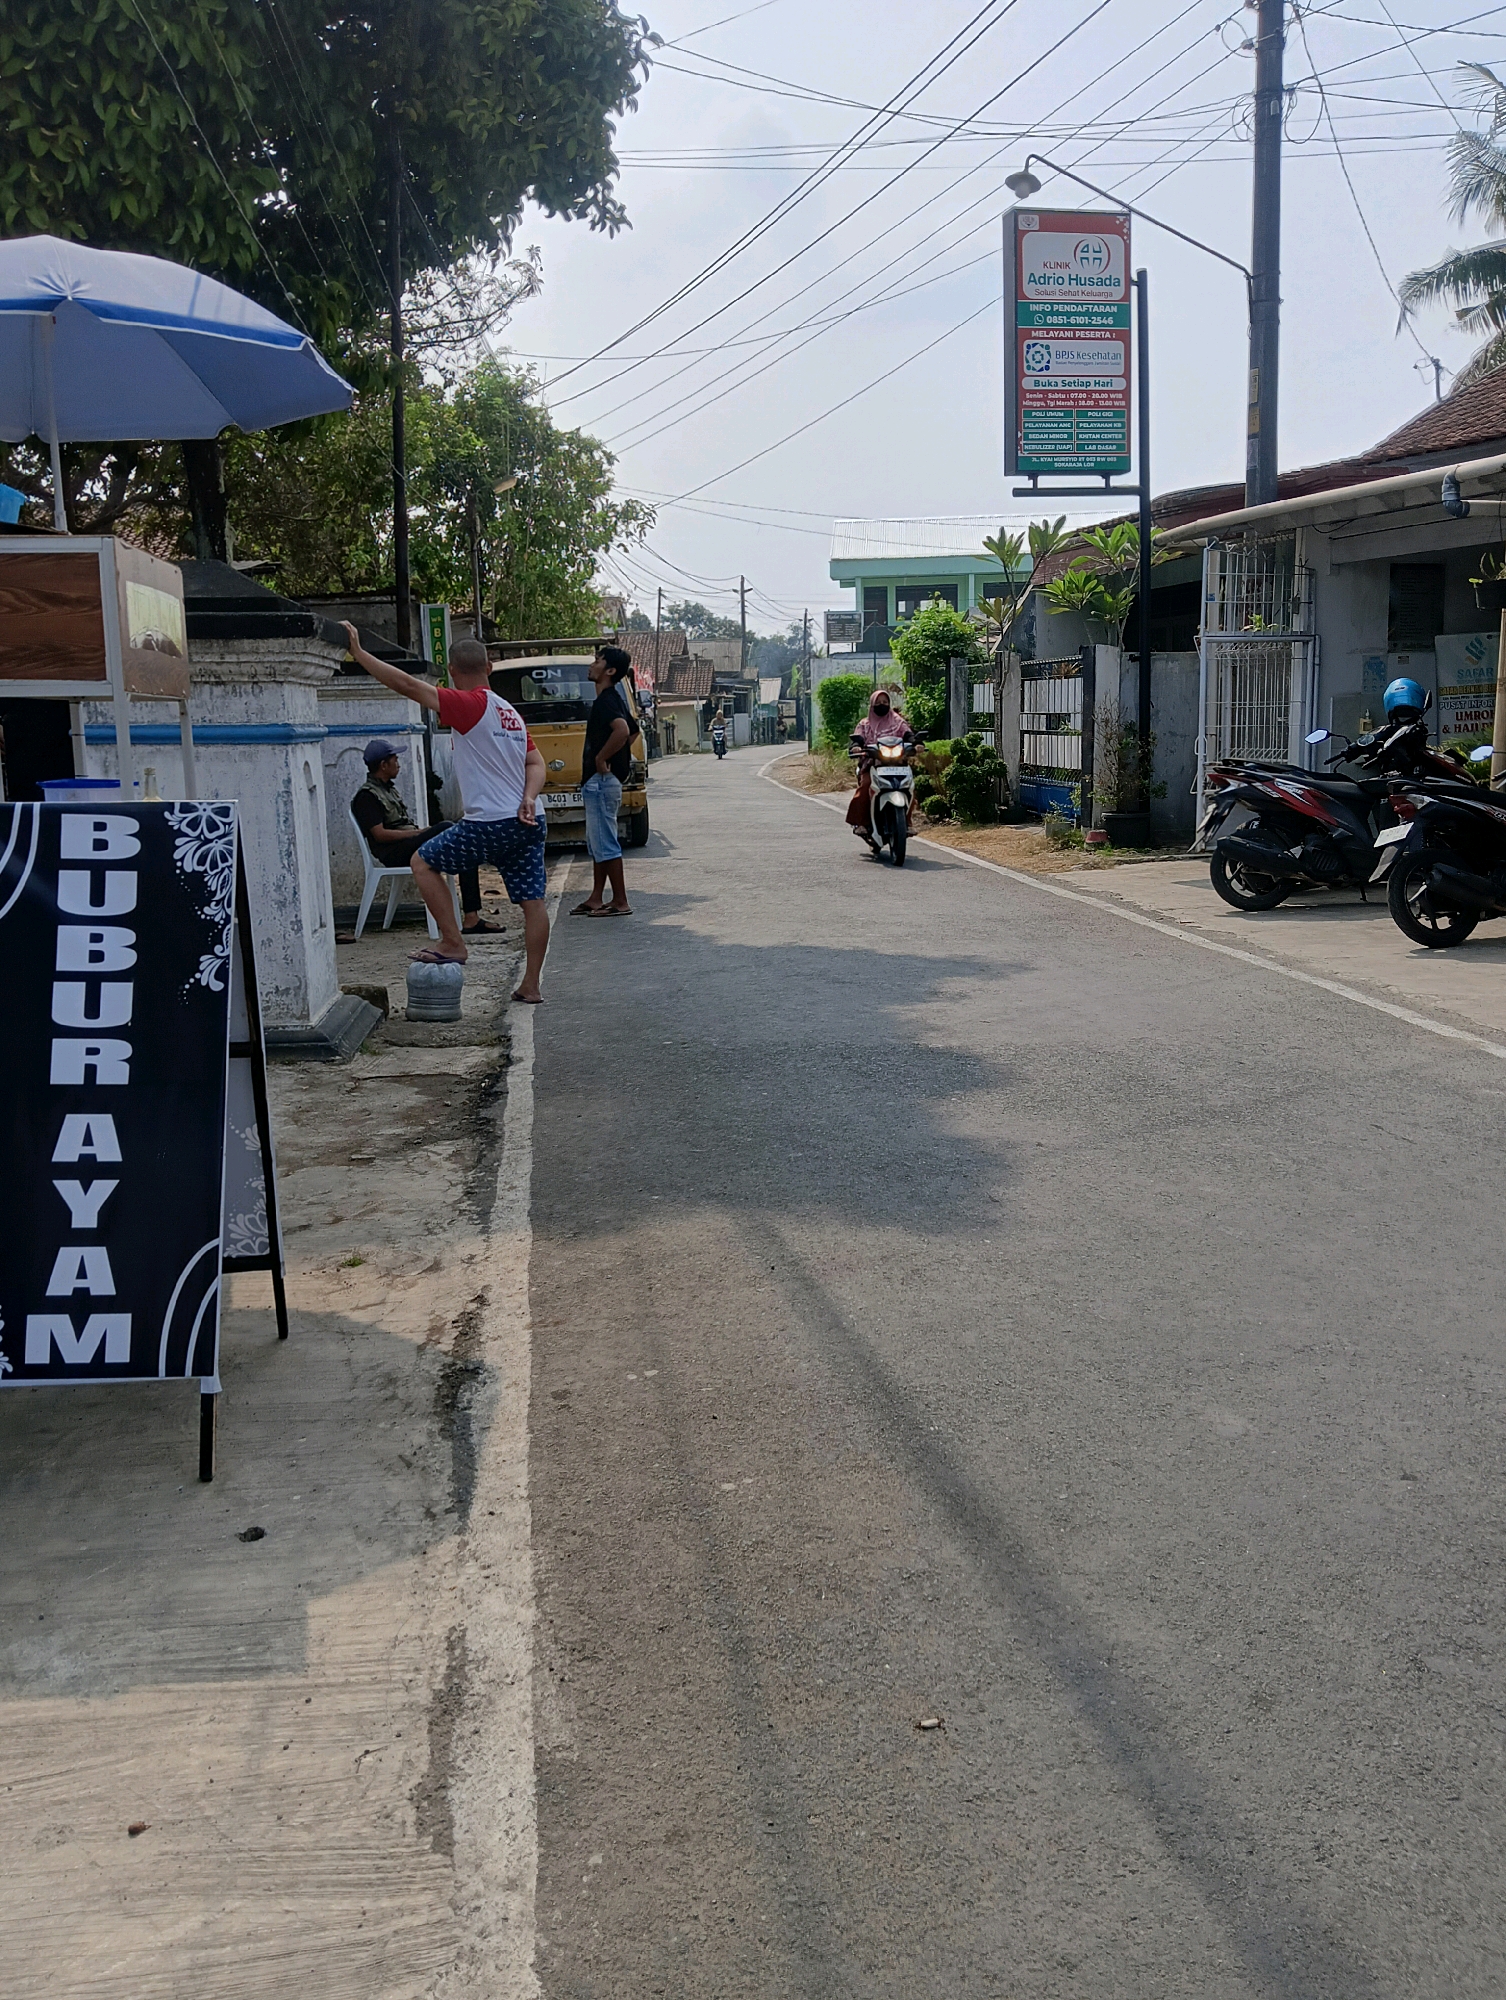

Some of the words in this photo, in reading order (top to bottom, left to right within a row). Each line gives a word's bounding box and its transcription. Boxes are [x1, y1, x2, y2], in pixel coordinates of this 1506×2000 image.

[1043, 261, 1071, 270] KLINIK
[1028, 272, 1065, 286] Adrio
[1068, 274, 1121, 287] Husada
[1034, 288, 1056, 296] Solusi
[1058, 289, 1080, 297] Sehat
[1081, 290, 1113, 299] Keluarga
[1029, 304, 1051, 312] INFO
[1053, 304, 1118, 313] PENDAFTARAN
[1046, 315, 1114, 325] 0851-6101-2546
[1031, 330, 1073, 338] MELAYANI
[1076, 331, 1111, 339] PESERTA
[1055, 350, 1075, 360] BPJS
[1076, 351, 1122, 361] Kesehatan
[1034, 379, 1058, 388] Buka
[1061, 379, 1091, 389] Setiap
[1094, 380, 1113, 388] Hari
[532, 669, 562, 679] ON
[1457, 668, 1494, 680] SAFAR
[1440, 701, 1466, 710] PUSAT
[1454, 722, 1479, 733] HAJI
[49, 813, 142, 1085] BUBUR
[25, 1113, 132, 1365] AYAM
